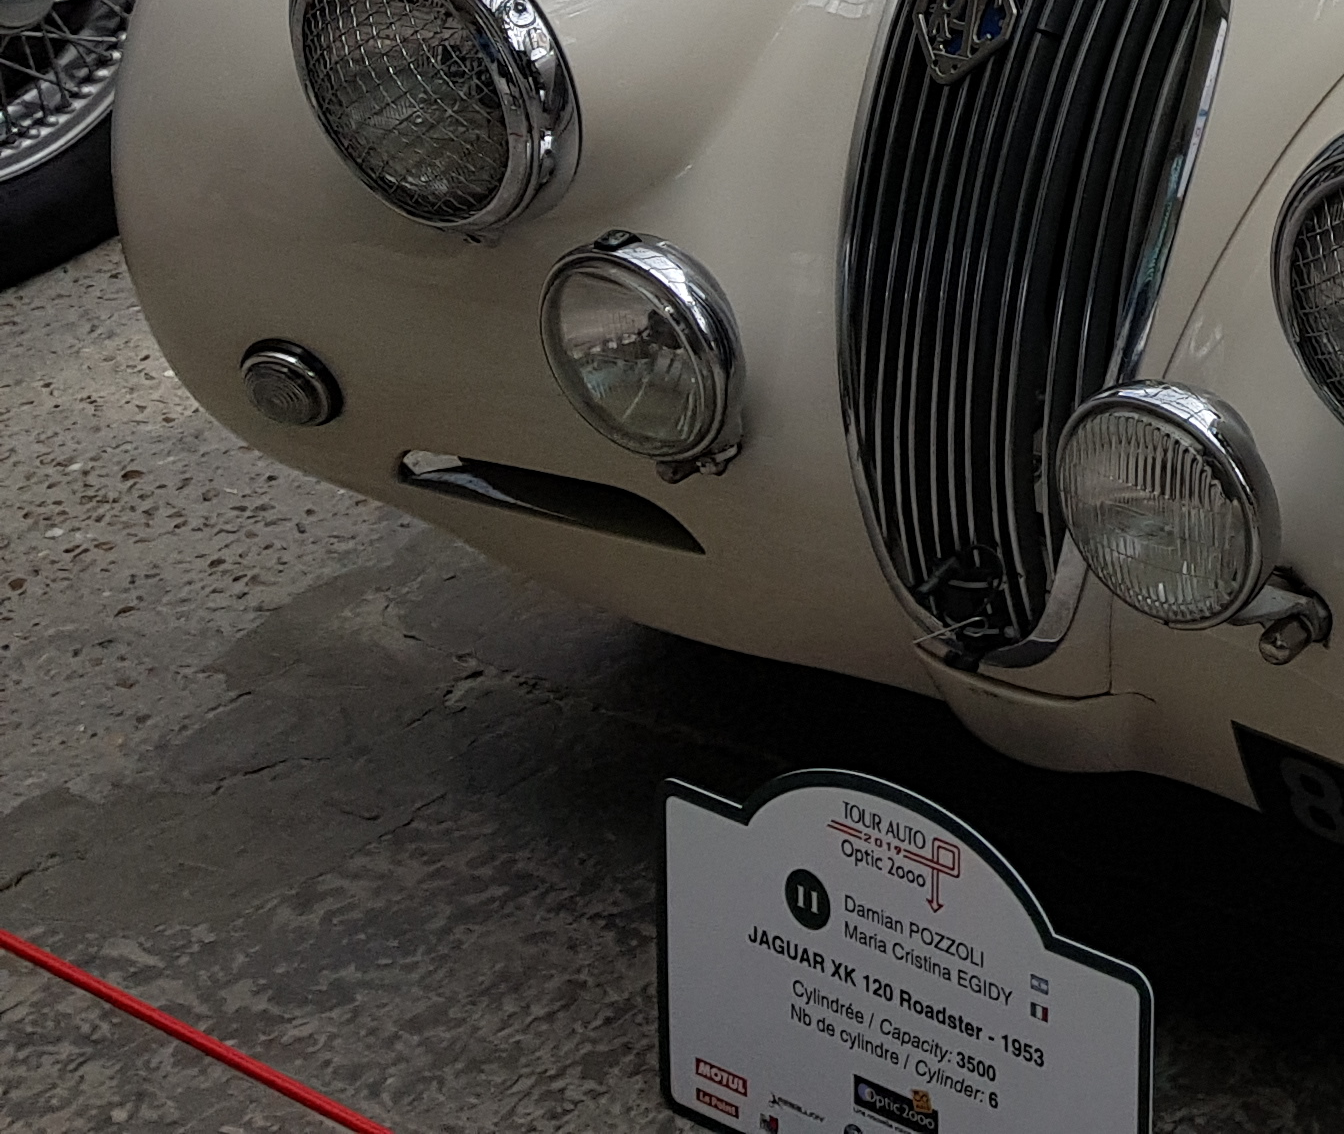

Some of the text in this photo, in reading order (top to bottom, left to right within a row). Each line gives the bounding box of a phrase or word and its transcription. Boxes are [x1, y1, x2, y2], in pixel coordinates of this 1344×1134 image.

[842, 801, 926, 849] TOUR AUTO
[862, 833, 902, 855] 2019
[841, 839, 926, 888] Optic 2000
[796, 883, 820, 916] 11
[844, 894, 985, 968] Damian POZZOLI
[844, 920, 1013, 1006] Maria Cristina EGIDY
[748, 925, 825, 973] JAGUAR
[830, 959, 857, 987] XK
[863, 975, 894, 1002] 120
[899, 989, 983, 1041] Roadster
[1001, 1035, 1045, 1068] 1953
[790, 1003, 812, 1027] Nb
[816, 1015, 836, 1037] de
[840, 1030, 899, 1065] cylindre
[915, 1059, 985, 1103] Cylinder:
[988, 1091, 999, 1109] 6
[792, 980, 864, 1025] Cylindrée
[879, 1019, 952, 1063] Capacity:
[956, 1051, 996, 1083] 3500
[698, 1061, 746, 1094] MOTUL
[711, 1095, 736, 1116] Point
